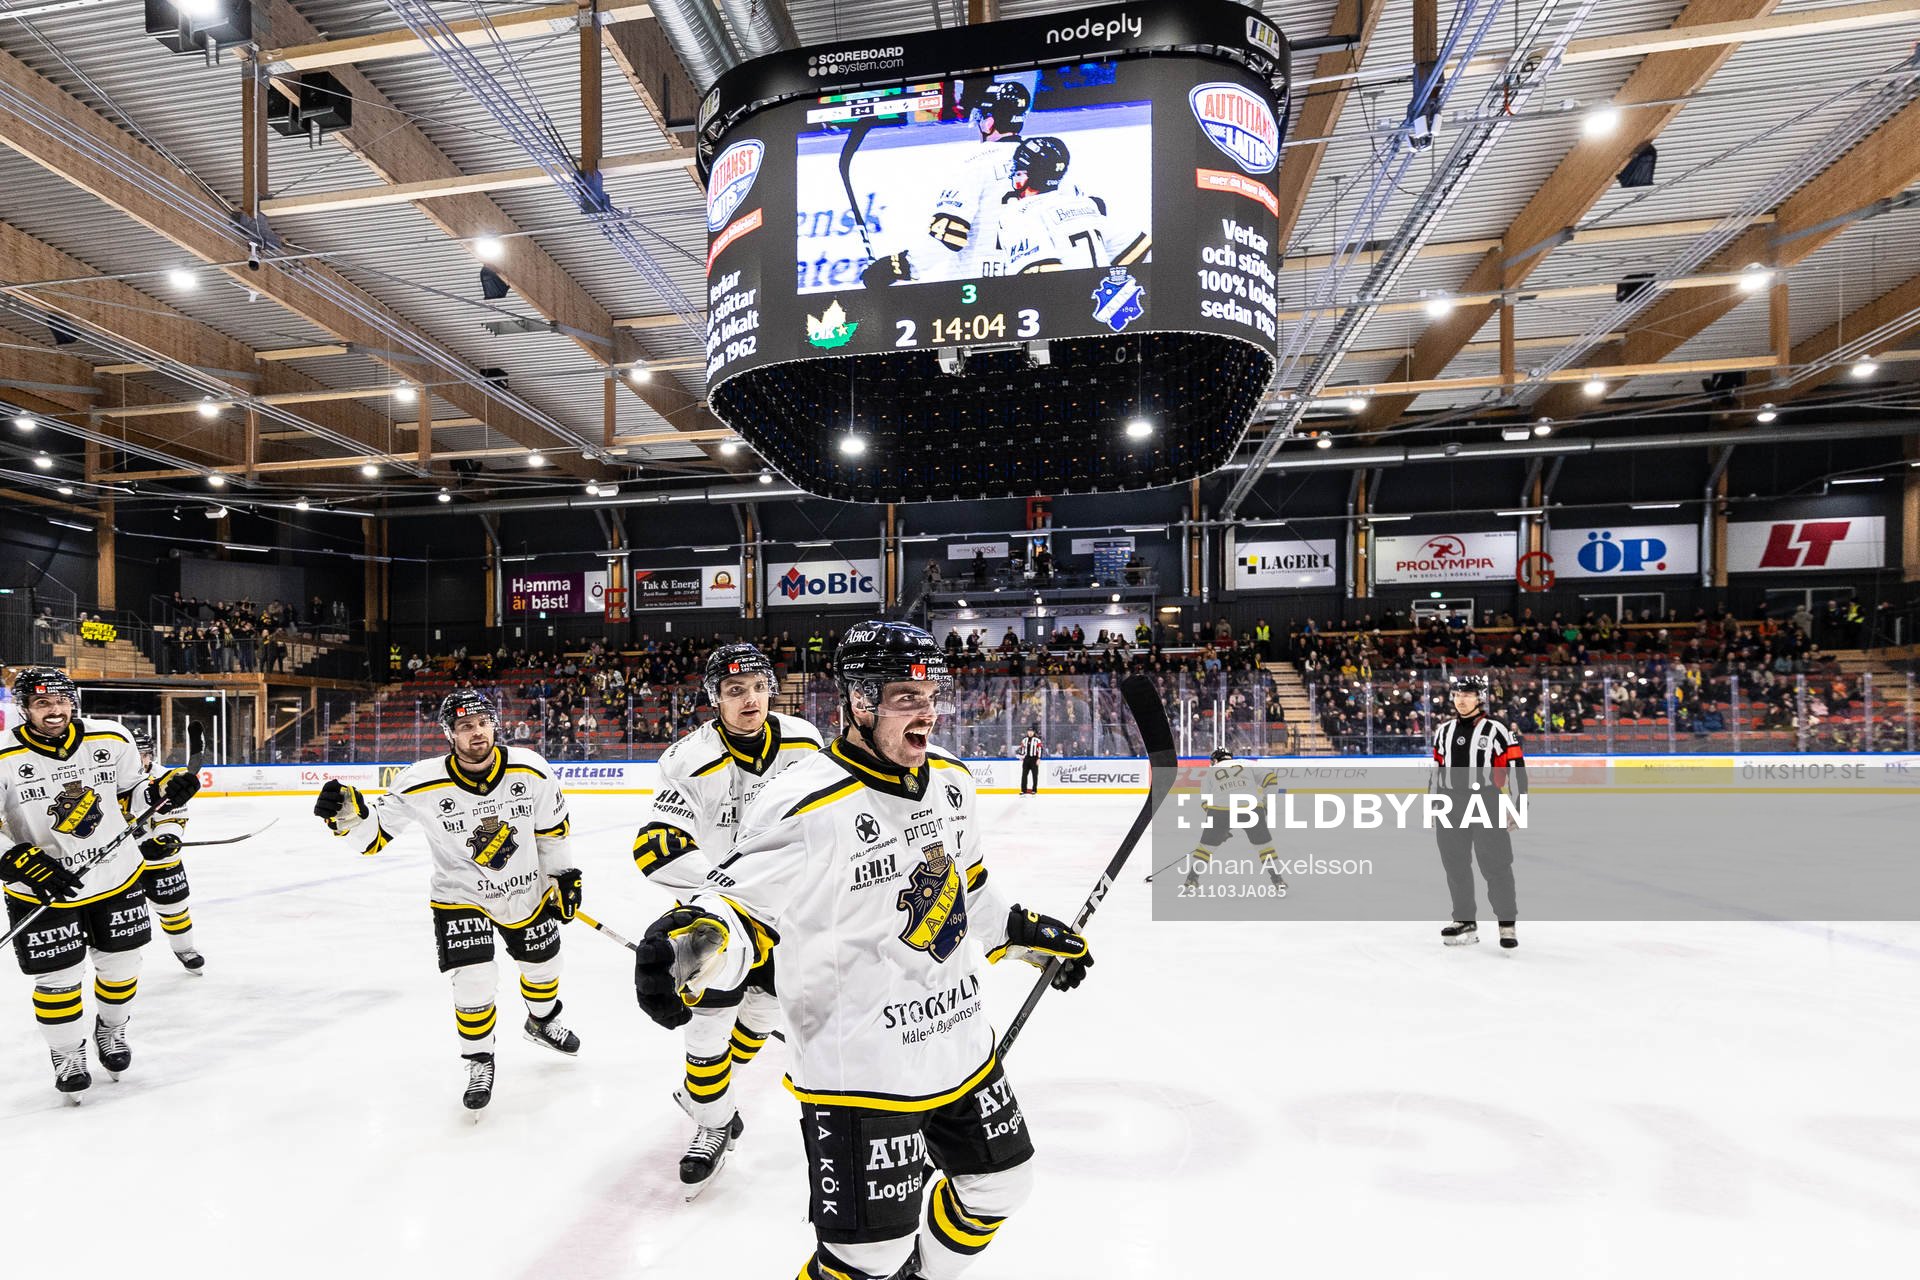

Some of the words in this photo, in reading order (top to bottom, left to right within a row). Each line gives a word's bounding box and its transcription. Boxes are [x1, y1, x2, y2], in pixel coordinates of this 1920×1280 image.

[1047, 13, 1142, 44] nodeply
[818, 46, 904, 65] SCOREBOARD
[838, 57, 904, 75] system.com
[1202, 245, 1237, 267] och
[1198, 269, 1247, 298] 100%
[961, 284, 977, 304] 3
[1201, 298, 1253, 327] sedan
[721, 309, 760, 342] lokalt
[895, 319, 918, 347] 2
[932, 313, 1006, 343] 14:04
[1017, 308, 1041, 337] 3
[725, 335, 757, 363] 1962
[1759, 521, 1850, 568] LT
[1396, 558, 1494, 572] PROLYMPIA
[512, 578, 571, 592] Hemma
[642, 580, 659, 590] Tak
[661, 580, 669, 589] &
[671, 579, 700, 590] Energi
[781, 568, 873, 597] MoBic
[512, 595, 527, 611] är
[531, 593, 569, 610] bäst!
[302, 772, 320, 781] ICA
[564, 766, 625, 778] attacus
[1060, 773, 1140, 784] ELSERVICE
[1304, 767, 1368, 778] MOTOR
[1742, 761, 1866, 780] ÖIKSHOP.SE
[910, 808, 934, 821] CCM
[156, 871, 186, 889] ATM
[850, 880, 873, 892] ROAD
[874, 871, 903, 886] RENTAL
[109, 904, 150, 926] ATM
[27, 921, 81, 947] ATM
[446, 917, 492, 937] ATM
[524, 918, 558, 941] ATM
[29, 939, 83, 959] Logistik
[447, 935, 494, 950] Logistik
[687, 1056, 707, 1065] CCM
[866, 1127, 928, 1171] ATM
[820, 1157, 840, 1216] KÖK
